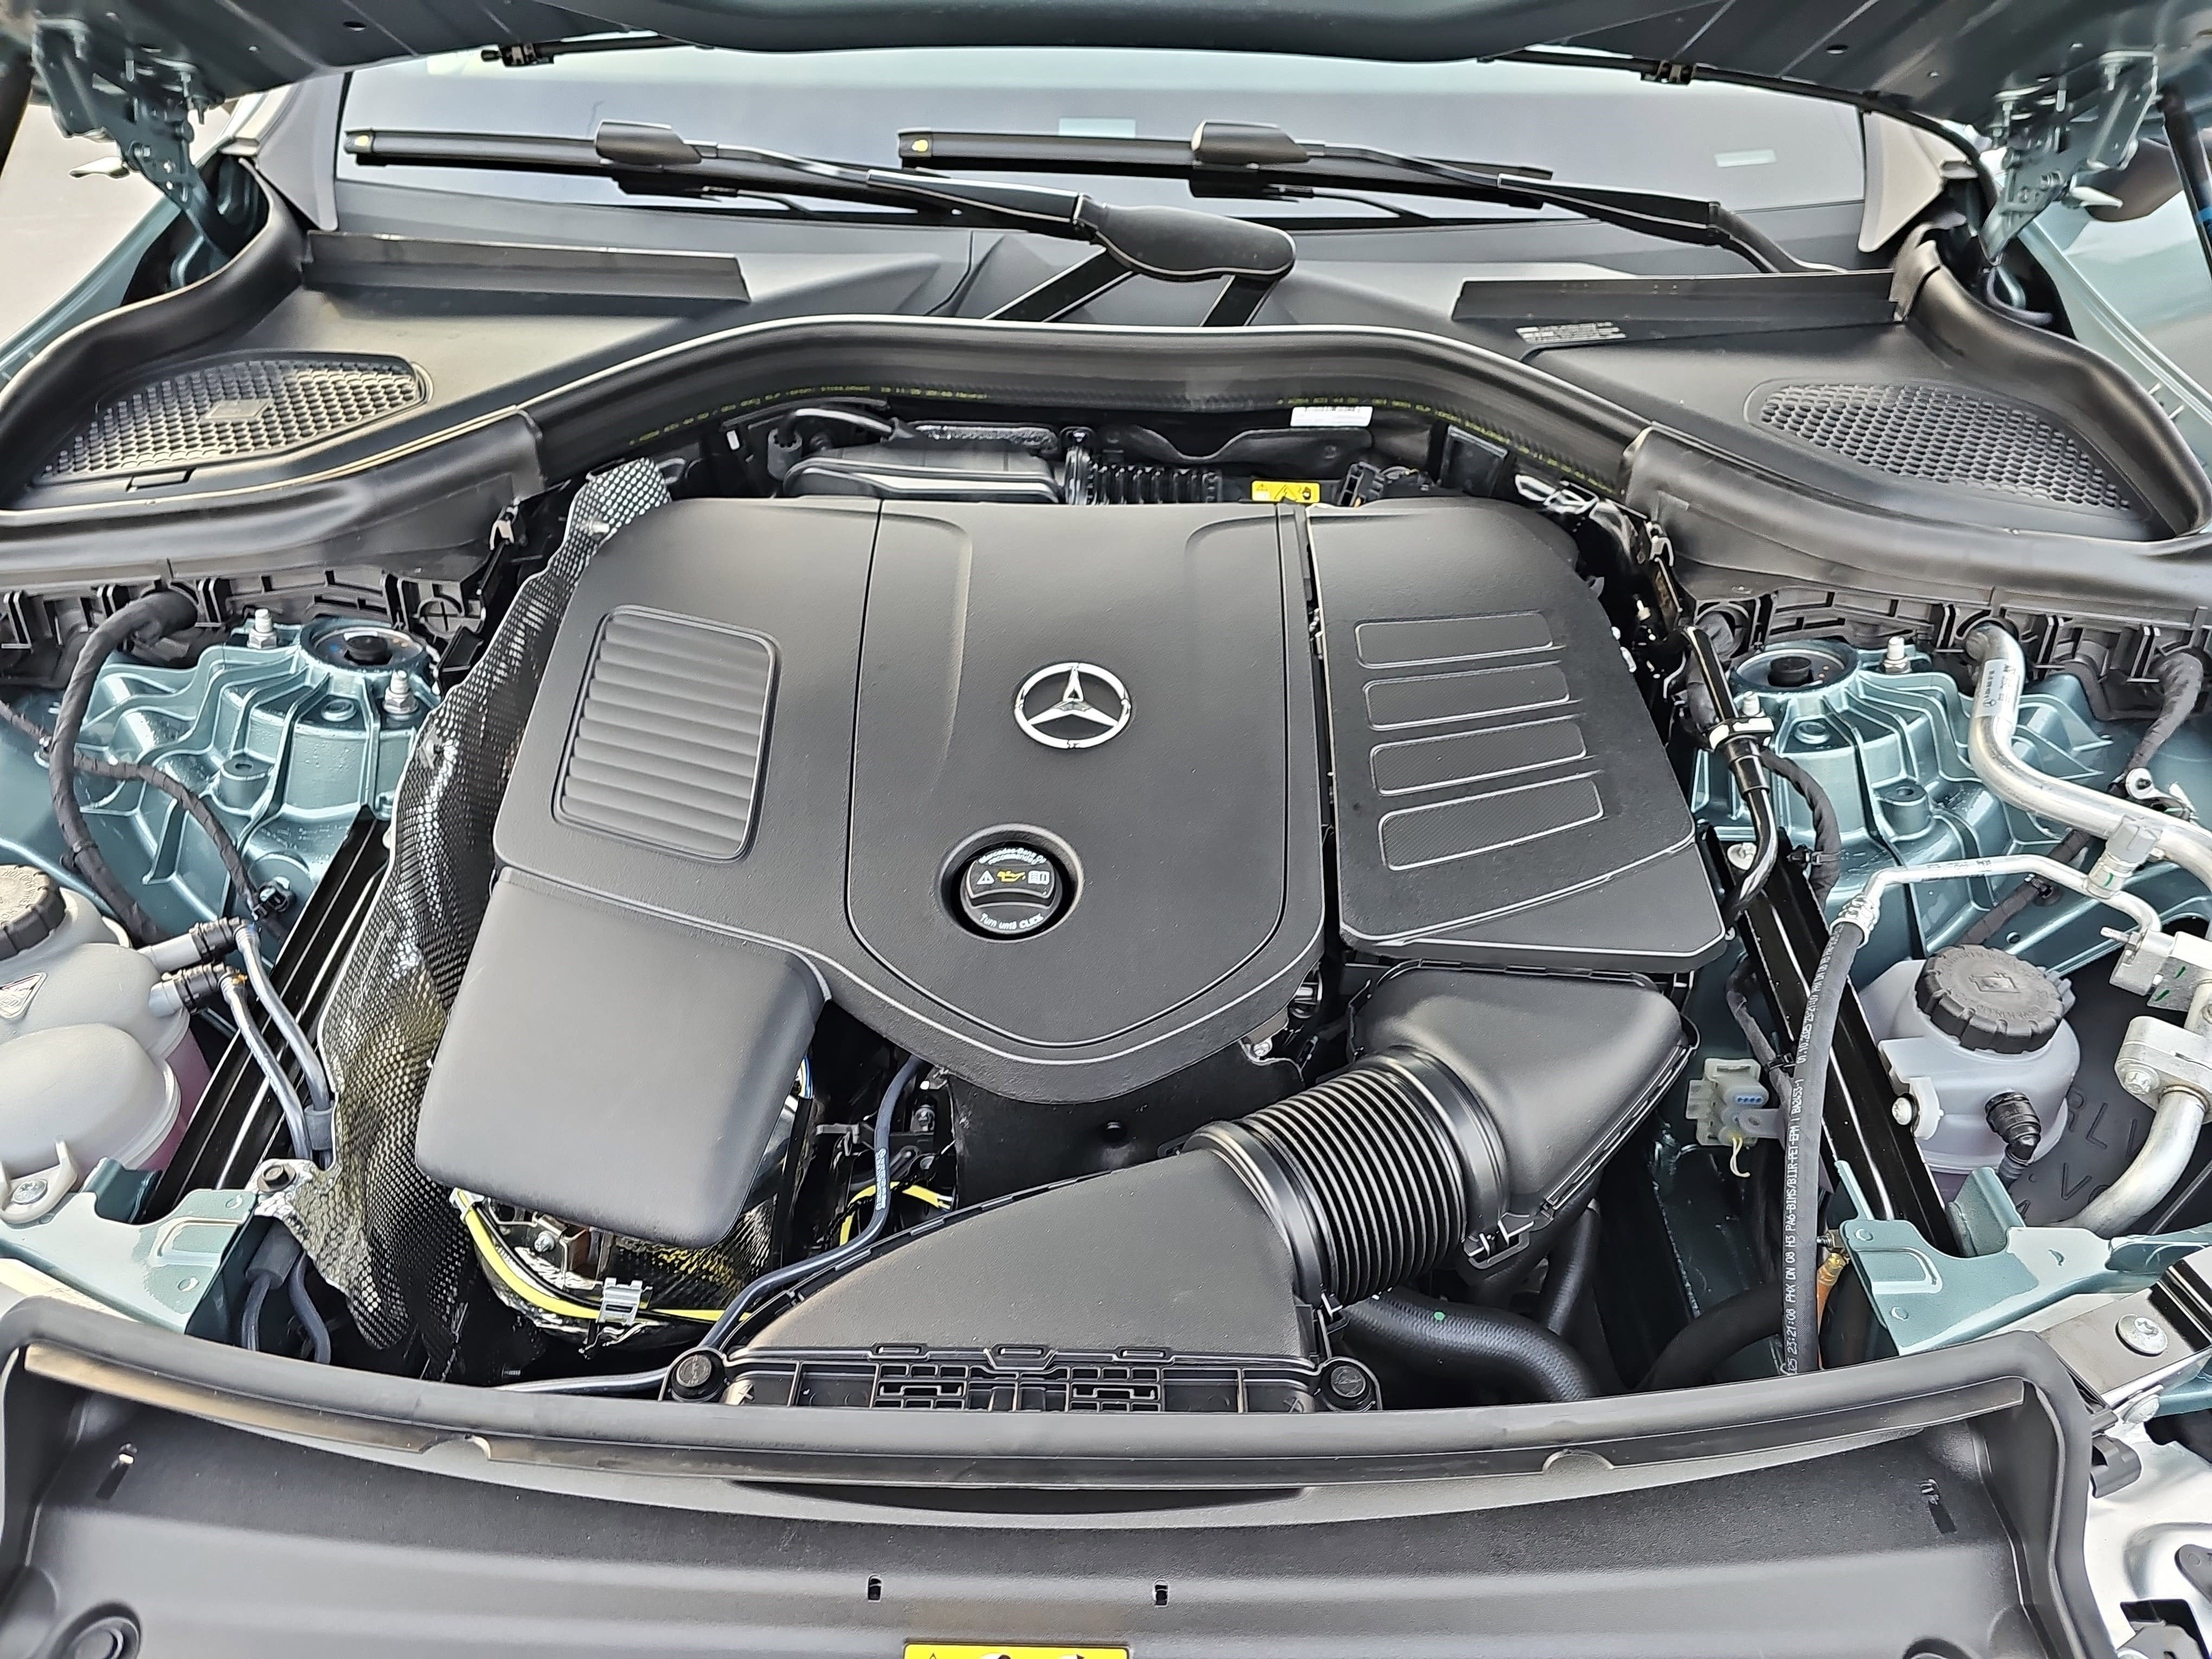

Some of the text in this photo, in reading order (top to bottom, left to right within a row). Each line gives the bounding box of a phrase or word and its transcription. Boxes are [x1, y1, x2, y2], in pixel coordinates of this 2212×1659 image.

[978, 847, 1037, 864] Mercedes-Benz
[988, 853, 1037, 865] recommended
[980, 912, 1044, 930] Turn until CLICK
[1791, 1078, 1805, 1115] BA2453-1
[1785, 1235, 1796, 1248] H3
[1785, 1251, 1796, 1264] 08
[1785, 1267, 1796, 1280] DN
[1785, 1283, 1796, 1302] PHX
[1786, 1308, 1797, 1355] 23:21:08
